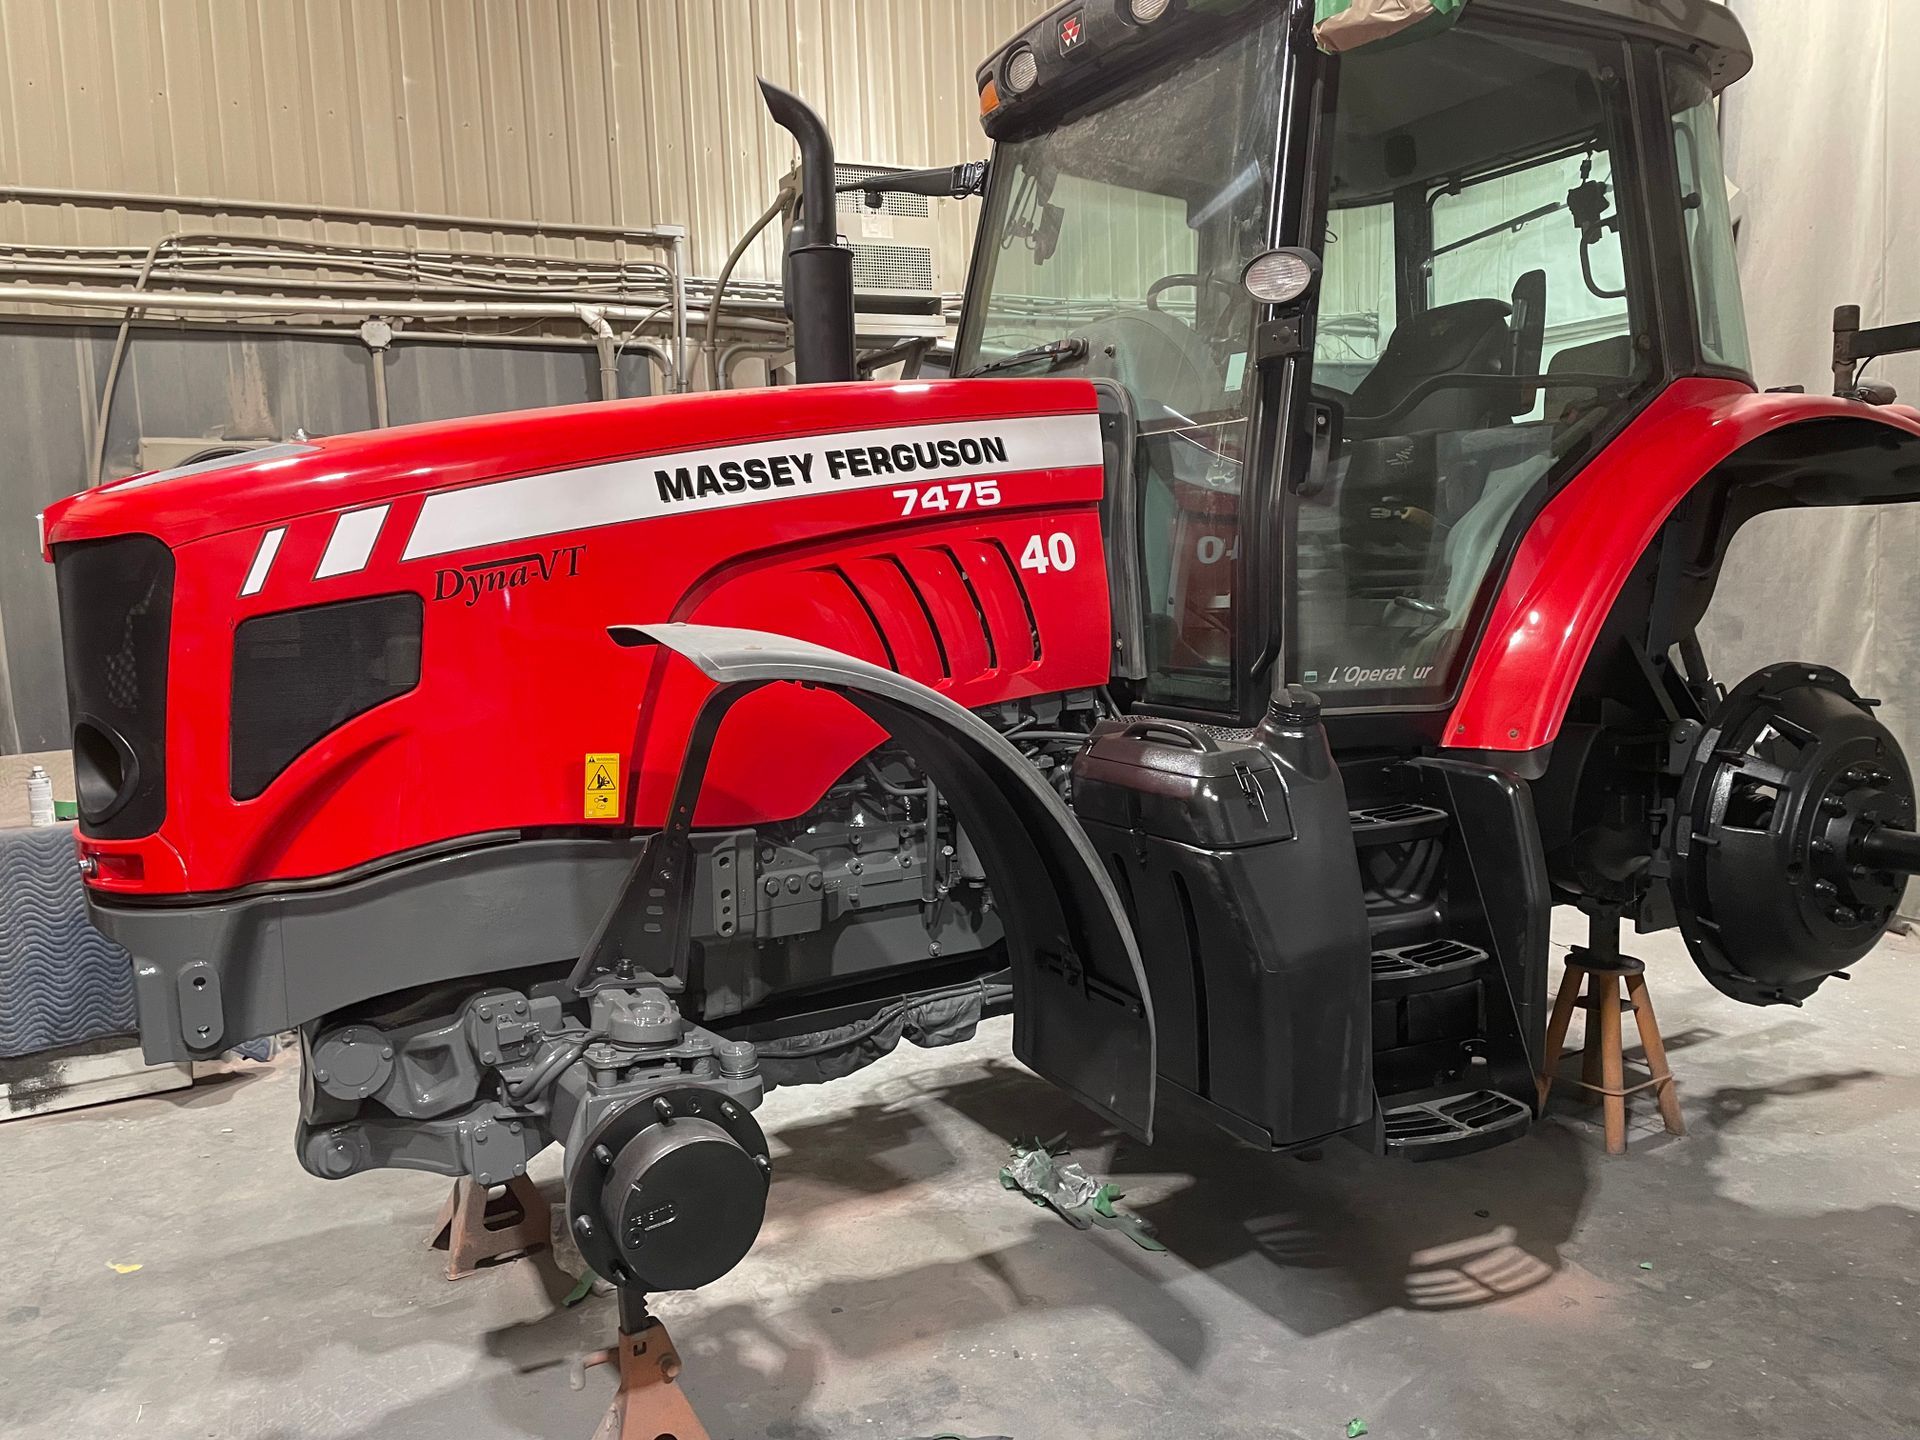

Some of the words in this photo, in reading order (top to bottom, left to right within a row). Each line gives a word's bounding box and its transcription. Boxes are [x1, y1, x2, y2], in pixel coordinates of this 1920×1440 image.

[654, 453, 814, 504] MASSEY
[825, 436, 1009, 480] FERGUSON
[892, 479, 1002, 516] 7475
[432, 544, 588, 607] Dyna-VT
[1019, 532, 1076, 574] 40
